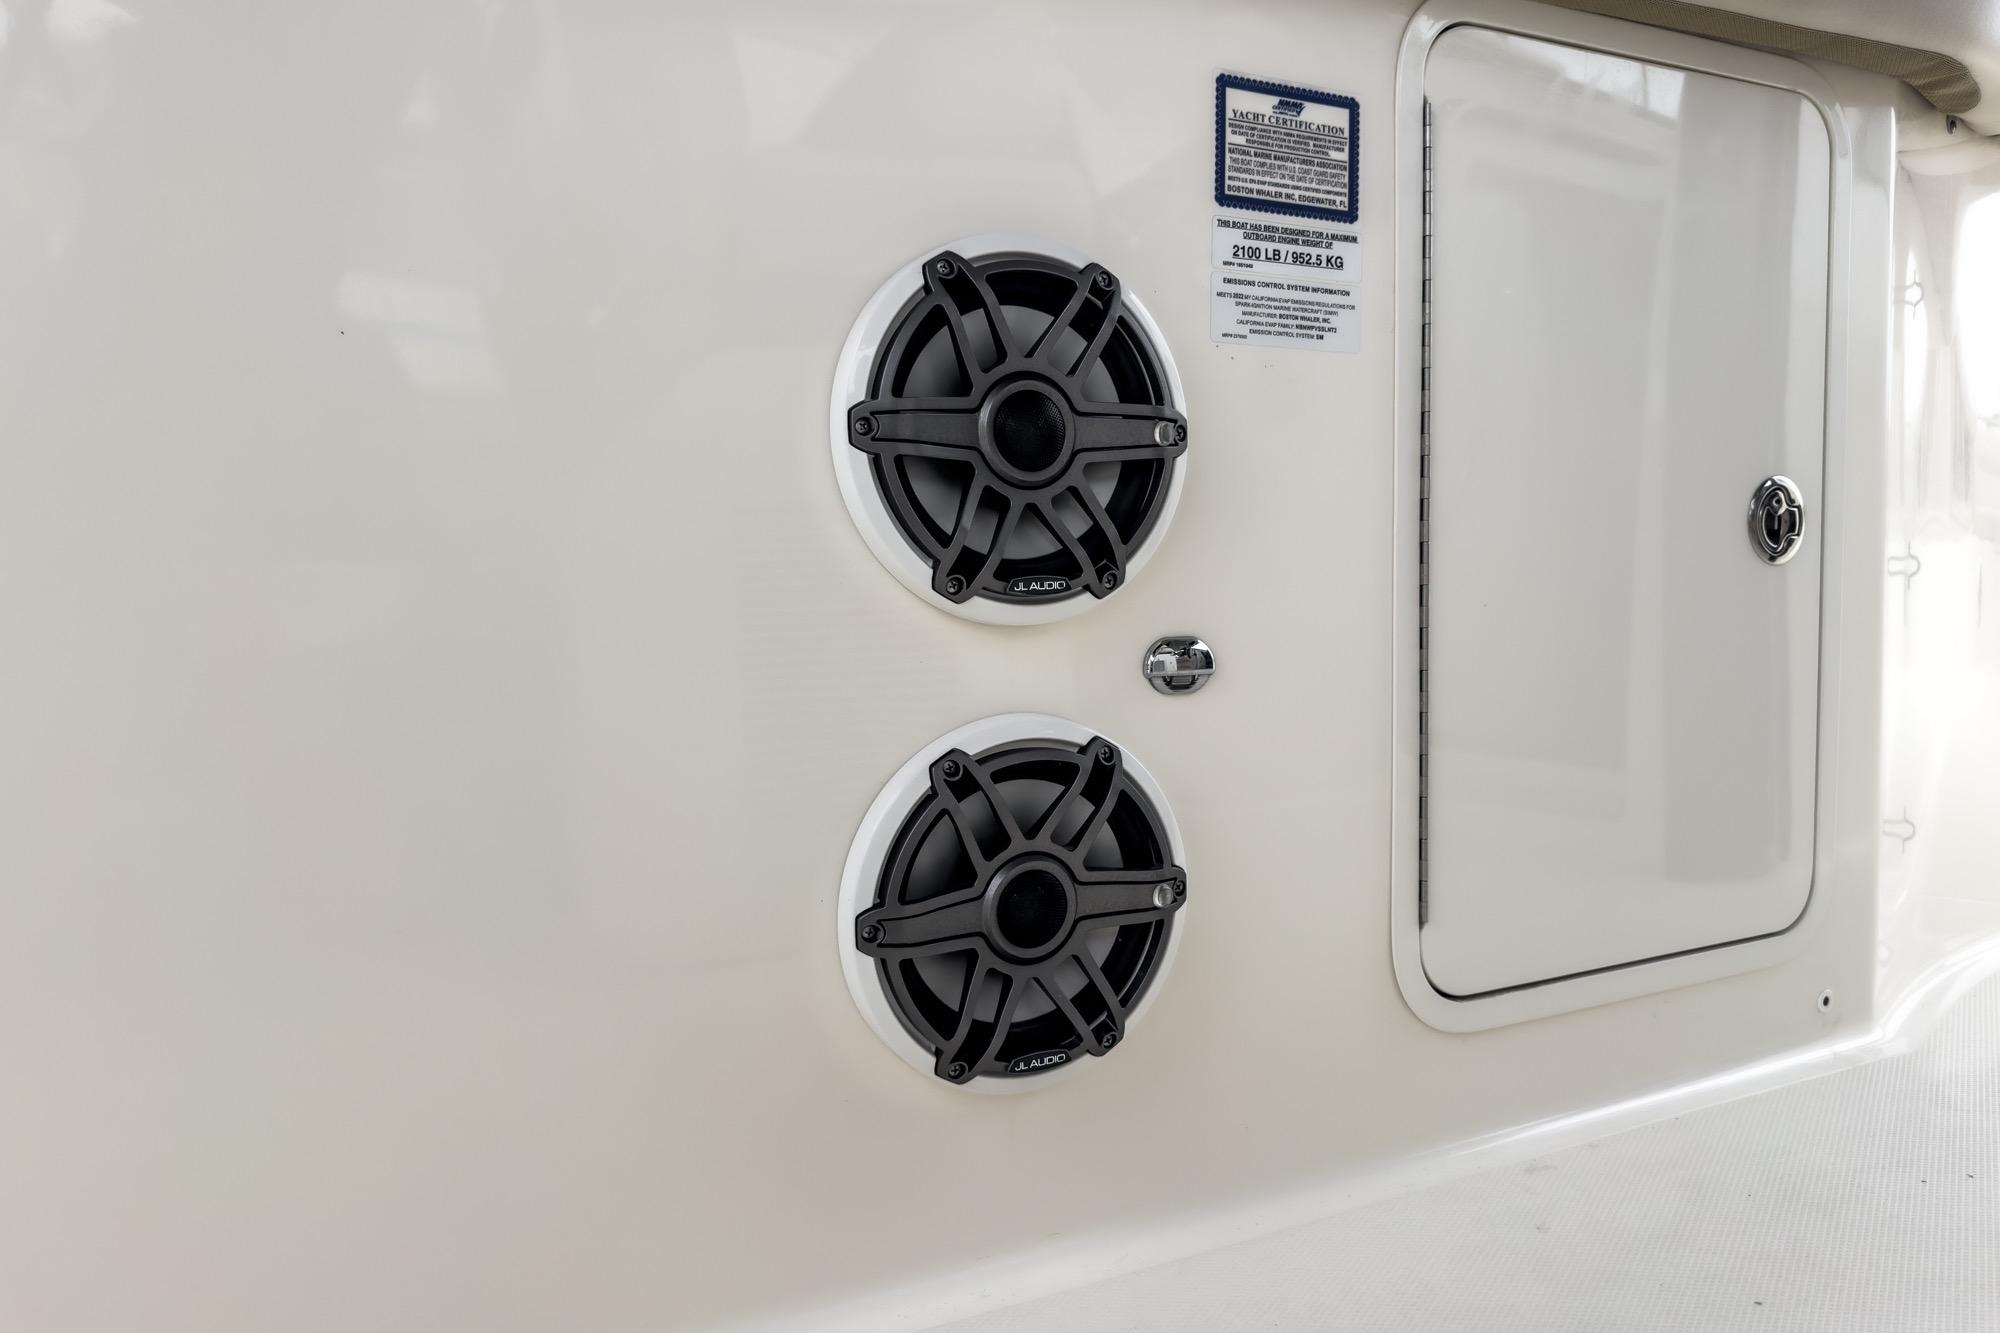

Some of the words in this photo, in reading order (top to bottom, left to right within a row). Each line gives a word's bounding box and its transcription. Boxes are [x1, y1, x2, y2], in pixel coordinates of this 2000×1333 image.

[1232, 109, 1267, 122] YACHT
[1268, 115, 1345, 136] CERTIFICATION
[1228, 147, 1252, 157] NATIONAL
[1254, 150, 1272, 160] MARINE
[1274, 153, 1315, 166] MANUFACTURERS
[1316, 160, 1347, 171] ASSOCIATION
[1229, 156, 1240, 165] THIS
[1241, 158, 1252, 166] BOAT
[1277, 164, 1288, 172] WITH
[1298, 167, 1312, 176] COAST
[1313, 169, 1329, 178] GUARD
[1329, 172, 1345, 181] SAFETY
[1228, 165, 1255, 176] STANDARDS
[1261, 170, 1278, 179] EFFECT
[1296, 175, 1307, 183] DATE
[1315, 178, 1347, 189] CERTIFICATION
[1227, 184, 1254, 195] BOSTON
[1256, 188, 1283, 199] WHALER
[1339, 200, 1347, 208] FL
[1217, 219, 1231, 228] THIS
[1232, 221, 1248, 230] BOAT
[1250, 223, 1262, 231] HAS
[1264, 224, 1280, 234] BEEN
[1281, 226, 1311, 237] DESIGNED
[1312, 230, 1324, 239] FOR
[1325, 232, 1330, 240] A
[1331, 232, 1358, 243] MAXIMUM
[1243, 231, 1277, 243] OUTBOARD
[1278, 235, 1300, 245] ENGINE
[1301, 238, 1324, 248] WEIGHT
[1325, 241, 1333, 249] OF
[1232, 244, 1261, 260] 2100
[1265, 247, 1281, 261] LB
[1284, 250, 1289, 263] /
[1291, 251, 1323, 267] 952.5
[1326, 255, 1344, 269] KG
[1223, 277, 1256, 287] EMISSIONS
[1257, 281, 1285, 290] CONTROL
[1286, 284, 1310, 292] SYSTEM
[1311, 286, 1350, 296] INFORMATION
[1279, 313, 1299, 321] BOSTON
[1249, 328, 1272, 336] EMISSION
[1273, 330, 1295, 338] CONTROL
[1014, 582, 1028, 591] JL
[1029, 580, 1066, 591] AUDIO
[1014, 1061, 1028, 1071] JL
[1030, 1053, 1066, 1068] AUDIO
